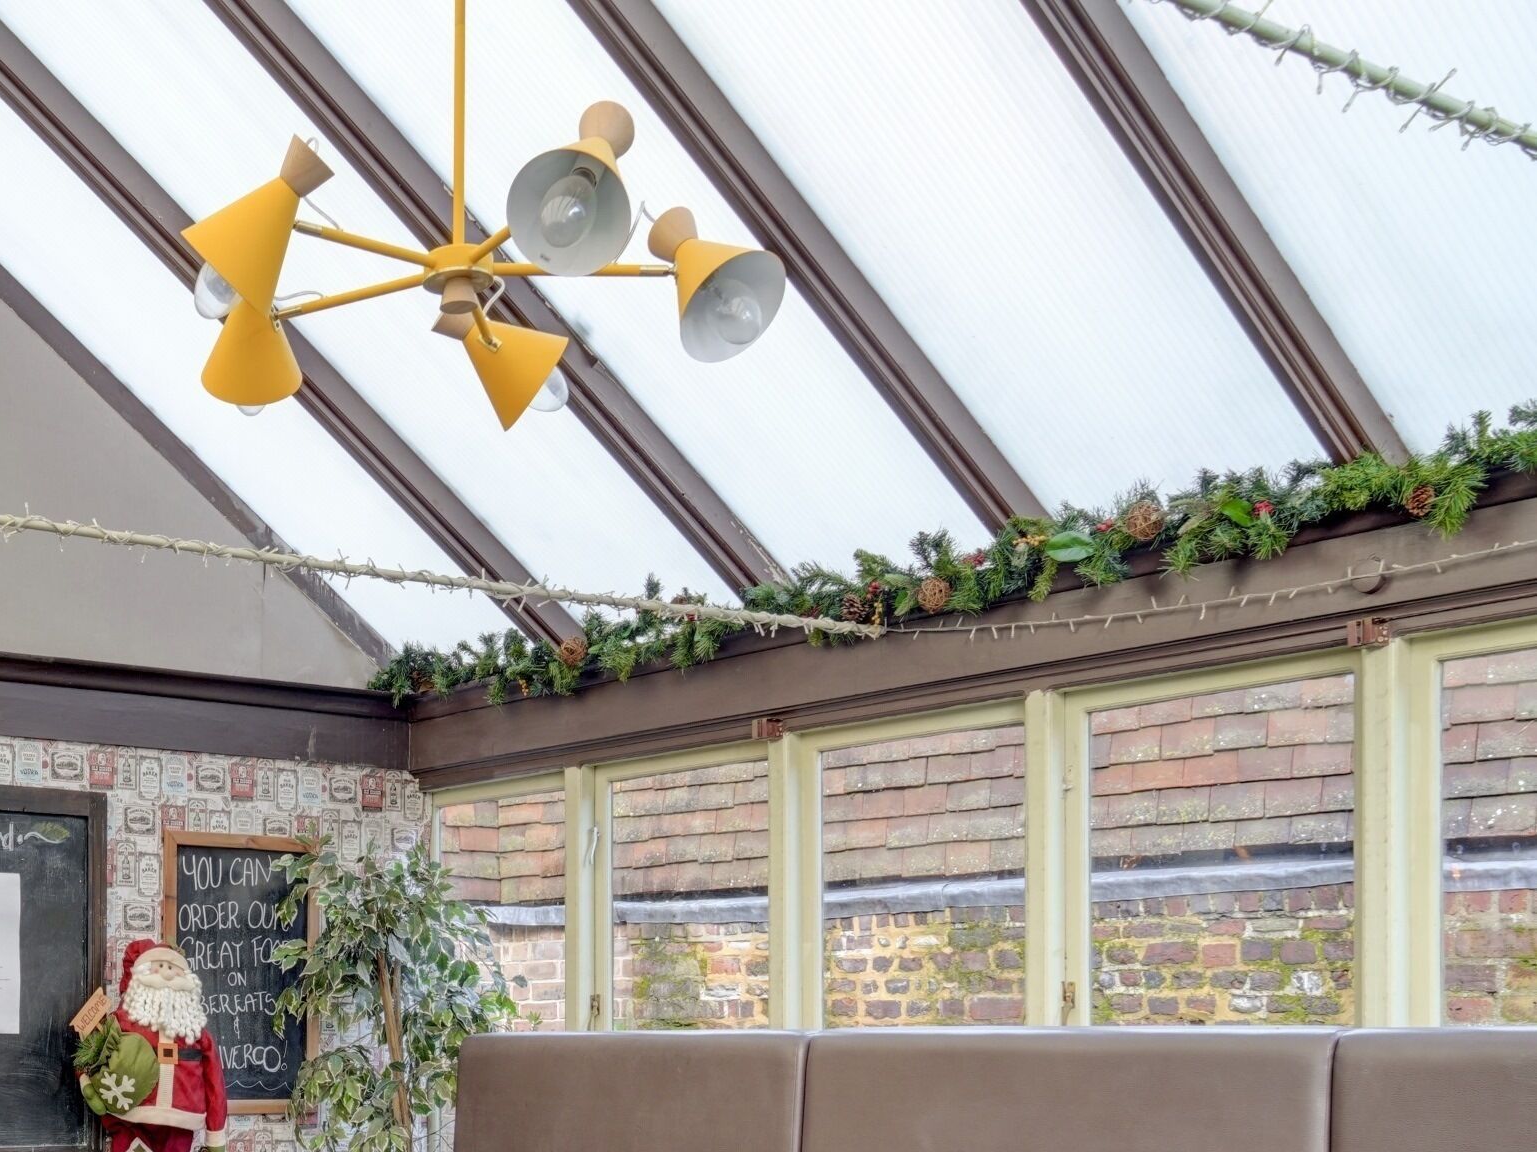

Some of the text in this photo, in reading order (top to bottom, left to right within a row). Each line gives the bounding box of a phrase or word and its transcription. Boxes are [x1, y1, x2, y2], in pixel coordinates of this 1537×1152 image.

[182, 854, 272, 891] YOU CAN
[178, 901, 240, 932] ORDER
[227, 971, 247, 987] ON
[76, 996, 107, 1031] WELCOME
